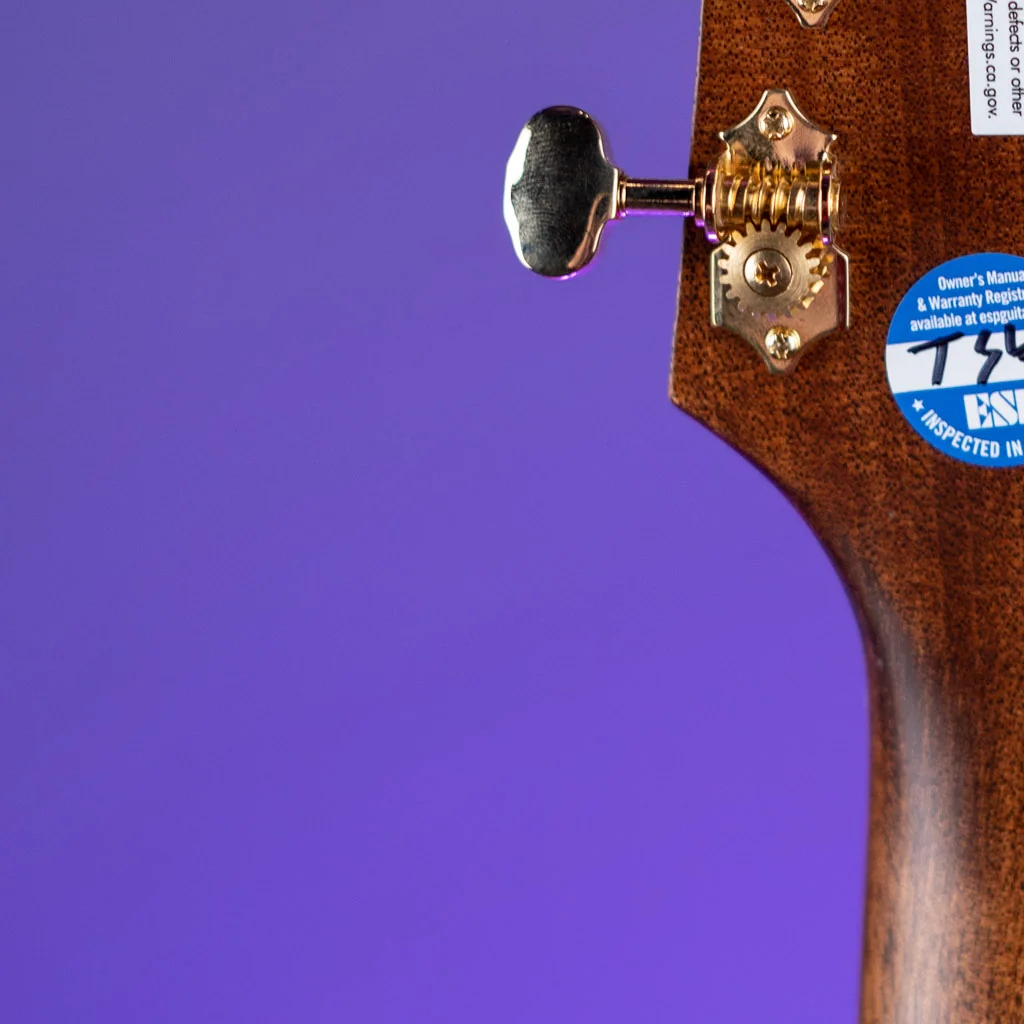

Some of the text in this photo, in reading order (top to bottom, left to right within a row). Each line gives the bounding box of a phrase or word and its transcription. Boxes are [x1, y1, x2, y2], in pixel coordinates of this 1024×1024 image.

[1008, 1, 1024, 52] defects
[1010, 57, 1020, 73] or
[938, 272, 984, 291] Owner's
[917, 297, 927, 312] &
[928, 291, 983, 310] Warranty
[910, 313, 962, 332] available
[965, 311, 977, 325] at
[920, 409, 1000, 458] INSPECTED
[1006, 439, 1023, 458] IN
